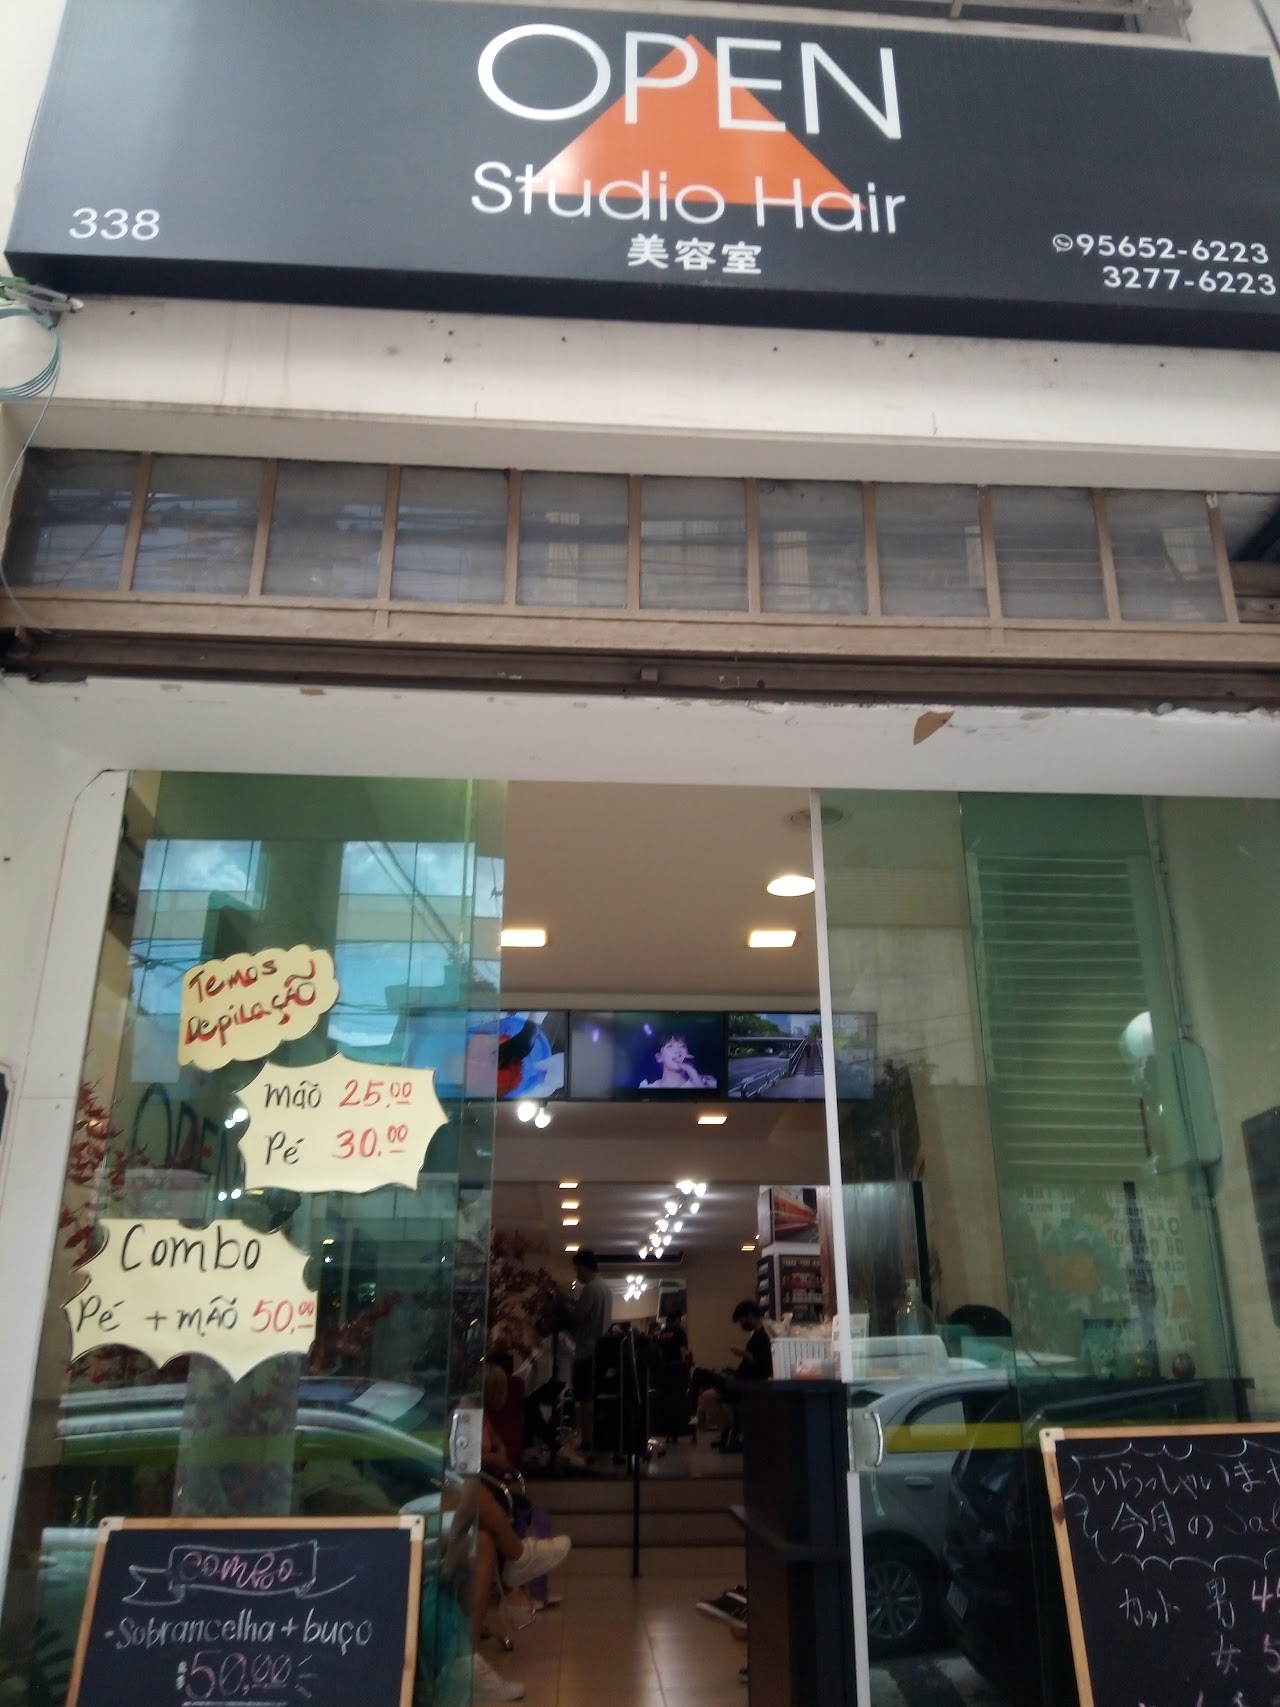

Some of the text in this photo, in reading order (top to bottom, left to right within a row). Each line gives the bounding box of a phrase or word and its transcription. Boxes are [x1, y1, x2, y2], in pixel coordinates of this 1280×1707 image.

[477, 23, 903, 140] OPEN
[471, 160, 906, 234] Studio Hair
[69, 207, 161, 241] 338
[627, 233, 762, 275] 美容室
[1076, 233, 1270, 265] 95652-6223
[1102, 265, 1277, 296] 3277-6223
[188, 959, 278, 1003] Temos
[264, 1130, 305, 1166] Pé
[121, 1223, 261, 1274] Combo
[75, 1295, 125, 1333] Pé
[1118, 1587, 1181, 1630] カット
[302, 1607, 374, 1656] buço
